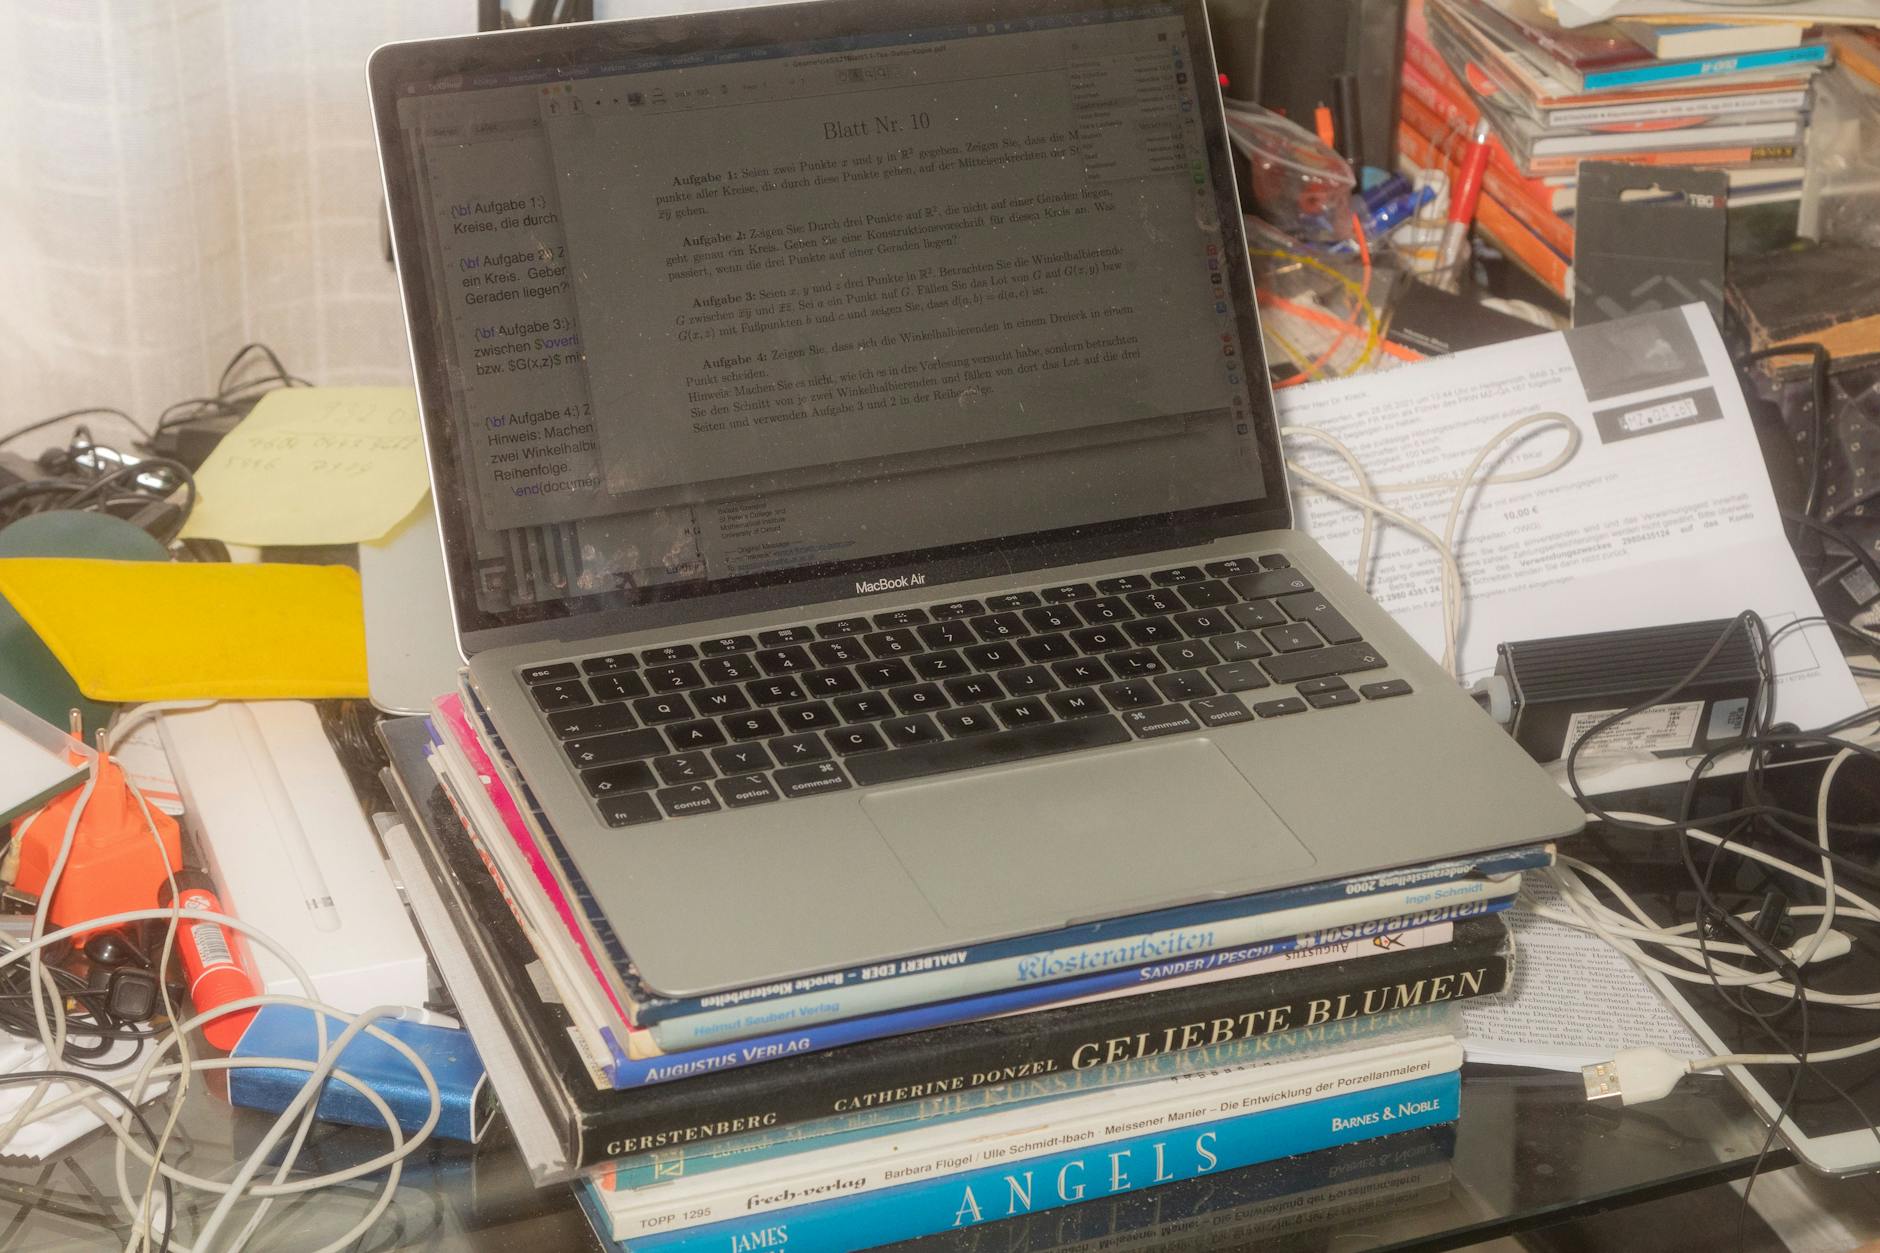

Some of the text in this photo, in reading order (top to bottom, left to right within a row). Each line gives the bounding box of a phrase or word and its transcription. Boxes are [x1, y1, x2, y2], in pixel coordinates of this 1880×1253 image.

[824, 112, 930, 139] Blatt Nr. 10
[673, 173, 721, 186] Aufgabe
[728, 171, 737, 179] 1:
[741, 168, 769, 178] Seien
[800, 160, 836, 172] Punkte
[475, 200, 526, 214] Aufgabe
[454, 212, 558, 234] Kreise, die durch
[683, 234, 731, 247] Aufgabe
[749, 228, 782, 239] Zeigen
[484, 252, 534, 267] Aufgabe
[462, 277, 481, 287] ein
[485, 273, 520, 284] Kreis.
[466, 290, 519, 304] Geraden
[693, 290, 786, 308] Aufgabe 3: Seien
[499, 322, 549, 336] Aufgabe
[474, 343, 531, 358] zwischen
[703, 350, 805, 369] Aufgabe 4: Zeigen
[476, 364, 504, 375] bzw.
[509, 410, 560, 425] Aufgabe
[488, 424, 593, 446] Hinweis: Machen
[491, 450, 518, 464] zwei
[494, 464, 571, 481] Reihenfolge.
[1504, 508, 1530, 520] 10,00
[856, 574, 925, 593] MacBook Air
[1235, 640, 1247, 649] Ä
[1211, 711, 1241, 719] option
[1143, 719, 1190, 731] command
[794, 744, 806, 752] X
[792, 777, 842, 790] command
[736, 790, 769, 799] option
[674, 799, 710, 809] control
[1346, 881, 1376, 894] 2000
[1406, 881, 1484, 904] Inge Schmidt
[1016, 927, 1217, 983] Klosterarbeiten
[1284, 942, 1350, 962] AUGUSTUS
[900, 952, 967, 973] ADALBERT
[1140, 959, 1204, 979] SANDER
[862, 964, 895, 979] EDER
[795, 973, 843, 990] Barocke
[701, 982, 792, 1007] Klosterarbeiten
[694, 1004, 840, 1038] Helmut Seubert Verlag
[608, 1113, 776, 1154] GERSTENBERG
[835, 1077, 963, 1110] CATHERINE
[972, 1060, 1057, 1085] DONZEL
[1072, 1006, 1291, 1070] GELIEBTE
[1304, 969, 1486, 1026] BLUMEN
[646, 1053, 736, 1082] AUGUSTUS
[743, 1038, 809, 1060] VERLAG
[1332, 1099, 1439, 1131] BARNES & NOBLE
[640, 1214, 676, 1230] TOPP
[682, 1207, 712, 1222] 1295
[748, 1178, 865, 1209] frech-verlag
[885, 1165, 931, 1180] Barbara
[936, 1155, 972, 1169] Flügel
[984, 1150, 1006, 1159] Ulle
[1010, 1131, 1094, 1154] Schmidt-Ibach
[1106, 1117, 1163, 1134] Meissener
[1168, 1109, 1206, 1121] Manier
[1221, 1102, 1238, 1111] Die
[1243, 1088, 1313, 1108] Entwicklung
[1316, 1083, 1334, 1092] der
[1338, 1061, 1430, 1087] Porzellanmalerei
[954, 1132, 1216, 1225] ANGELS
[732, 1225, 787, 1252] JAMES
